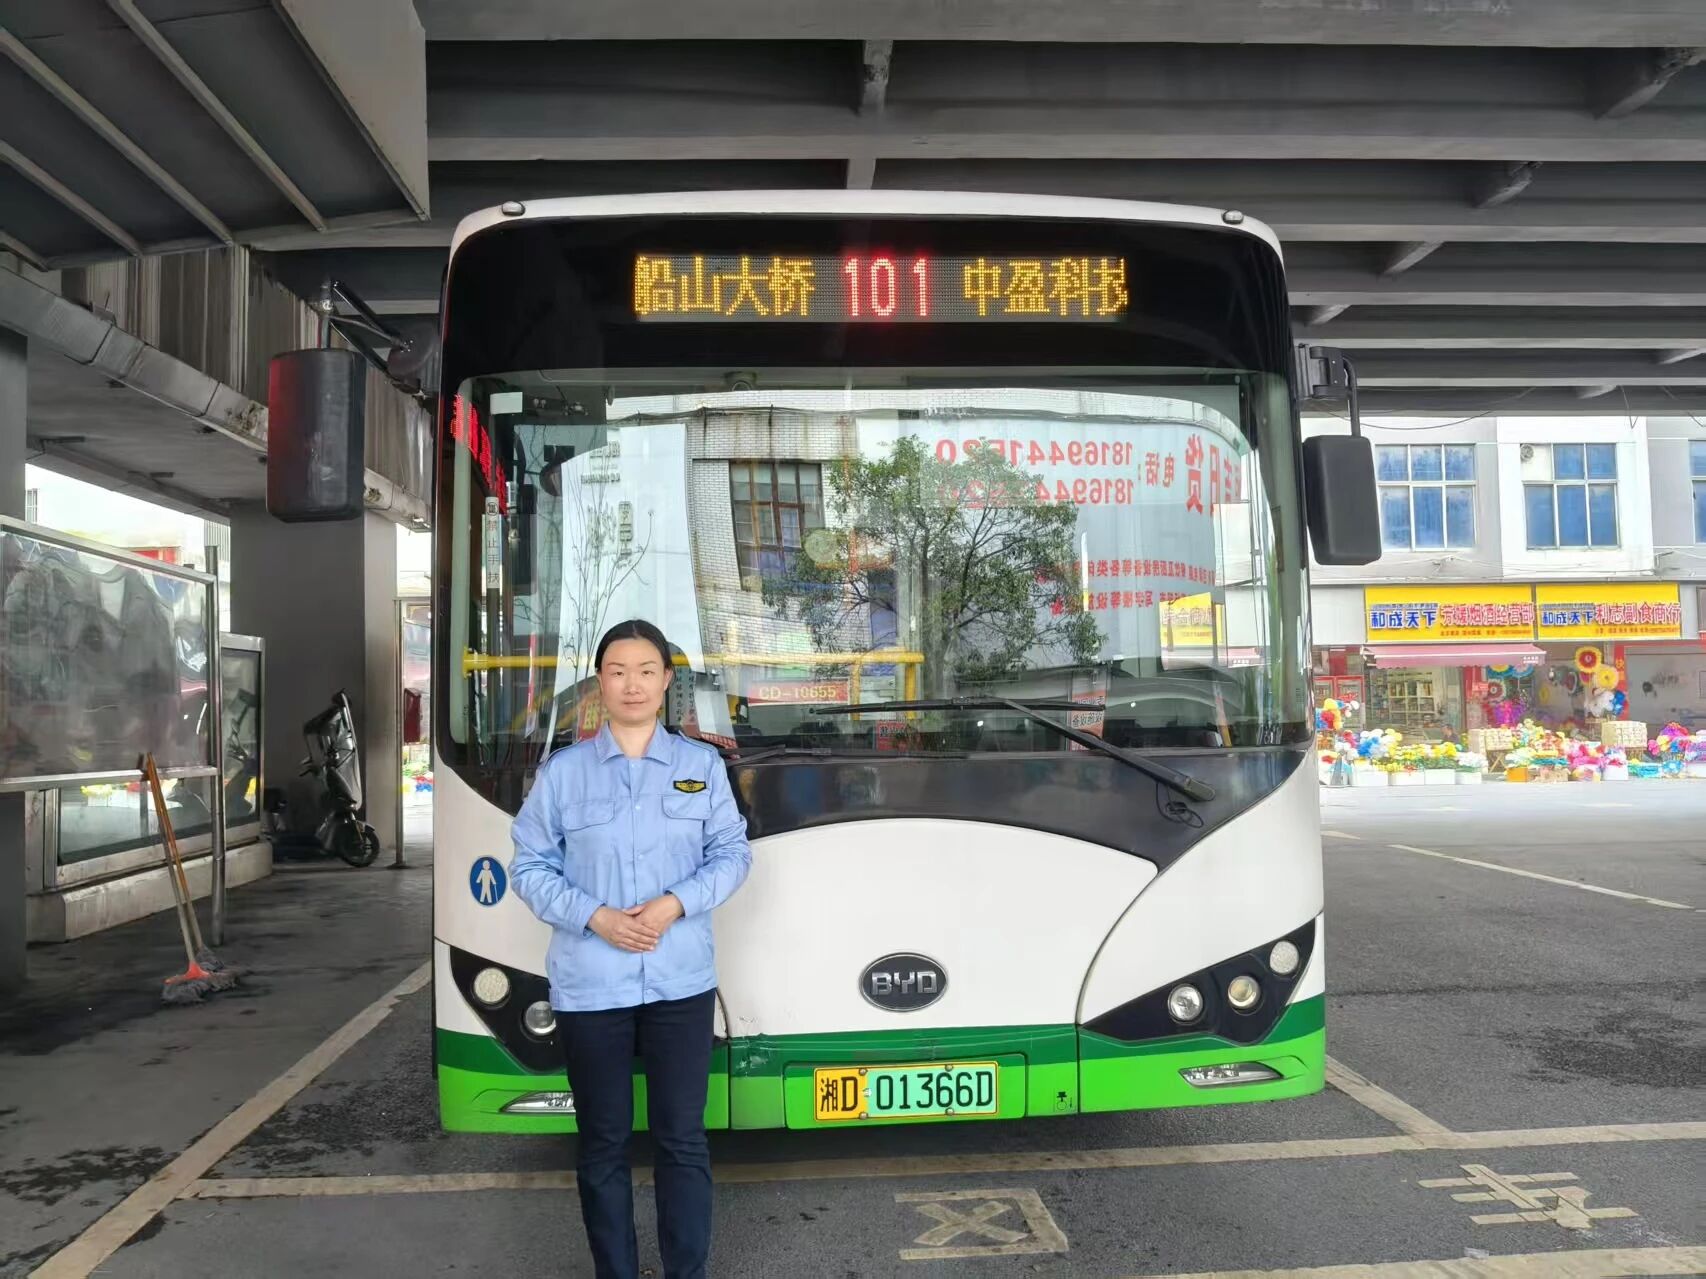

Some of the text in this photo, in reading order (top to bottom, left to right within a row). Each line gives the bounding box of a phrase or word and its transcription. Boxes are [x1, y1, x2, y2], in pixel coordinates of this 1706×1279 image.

[634, 256, 1129, 316] 船山大桥 101 中盈科技
[1370, 610, 1437, 630] 和成天下
[1541, 610, 1595, 627] 和成天下
[871, 970, 938, 996] BYD
[820, 1070, 994, 1112] 湘D 01366D
